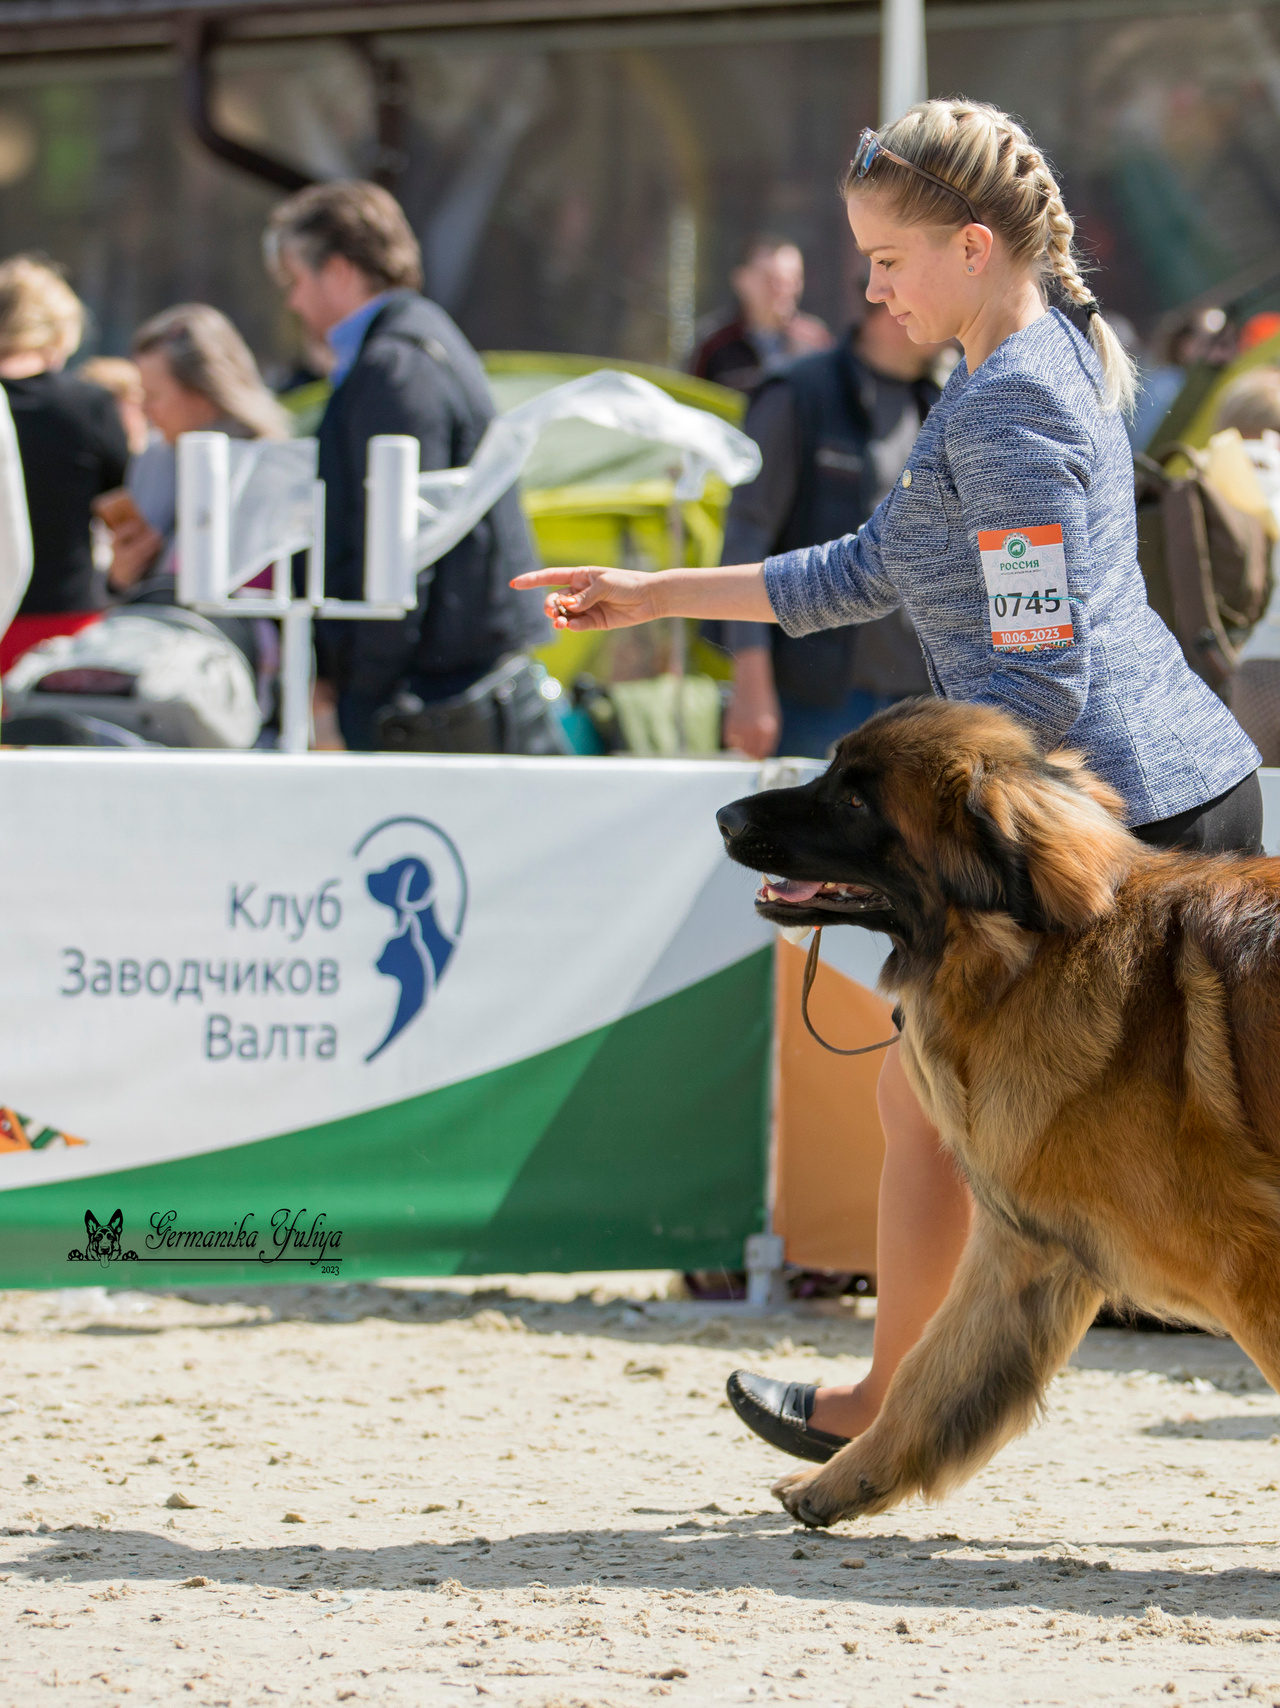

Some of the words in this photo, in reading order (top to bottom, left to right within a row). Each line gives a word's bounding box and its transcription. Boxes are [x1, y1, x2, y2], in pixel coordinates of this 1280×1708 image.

[1000, 559, 1040, 571] РОССИЯ
[994, 588, 1061, 618] 0745
[1001, 627, 1060, 644] 10.06.2023
[228, 879, 343, 939] Клуб
[60, 949, 340, 1004] Заводчиков
[205, 1015, 338, 1061] Валта
